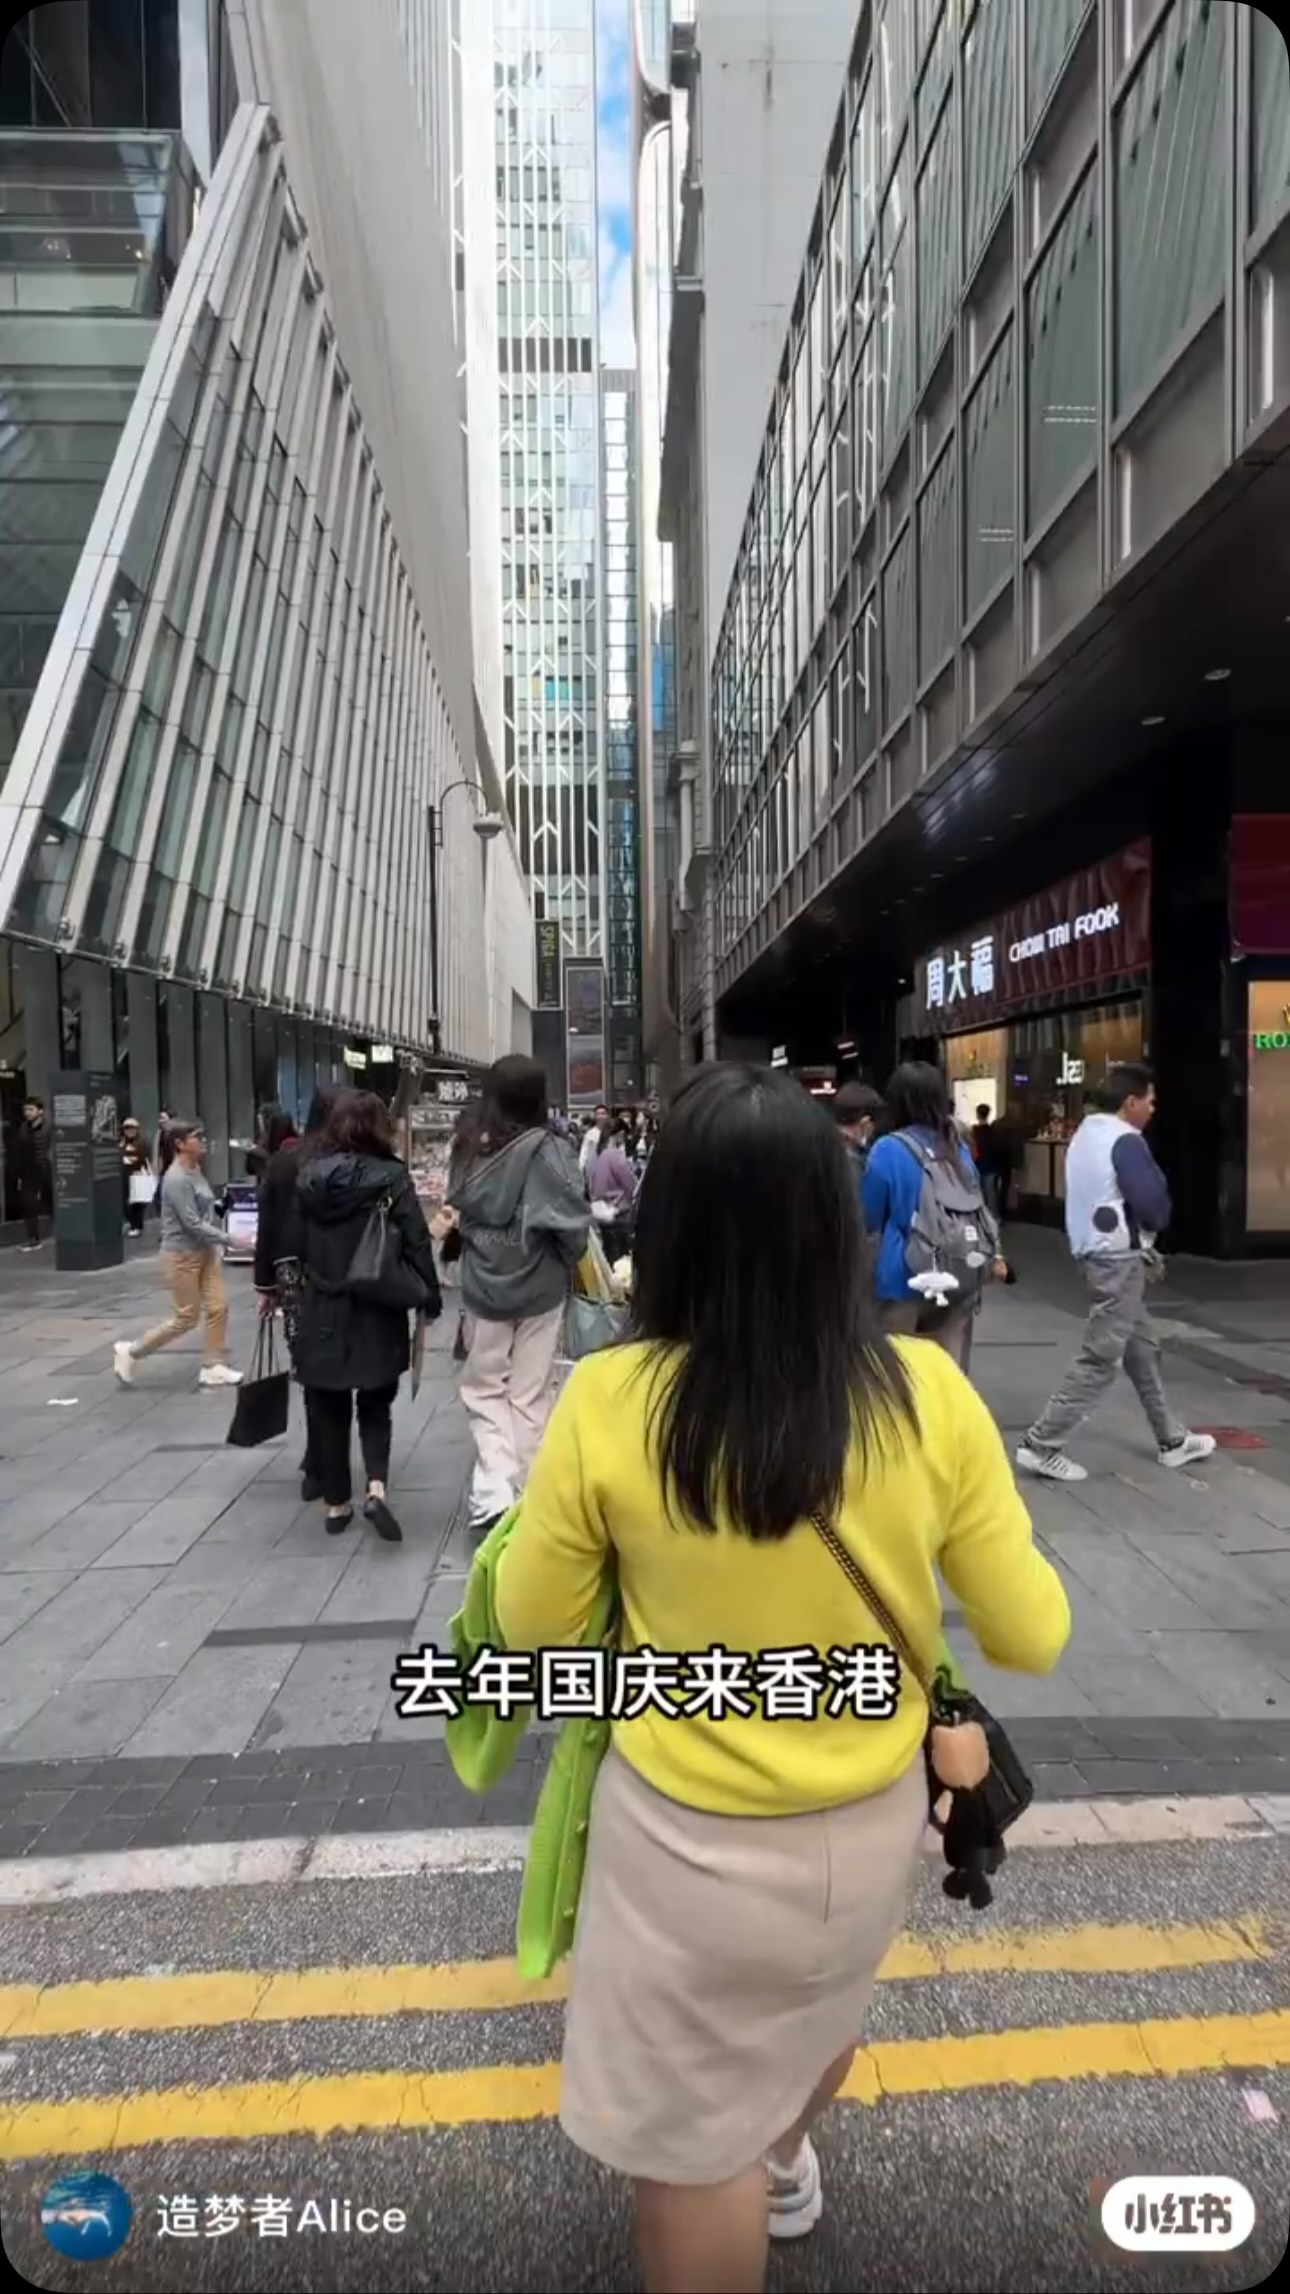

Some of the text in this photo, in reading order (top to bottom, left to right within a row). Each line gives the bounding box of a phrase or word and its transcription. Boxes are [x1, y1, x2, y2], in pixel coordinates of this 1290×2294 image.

[1009, 902, 1120, 963] CHOW TAI FOOK
[926, 935, 994, 1010] 周大福
[1255, 1031, 1290, 1050] RO
